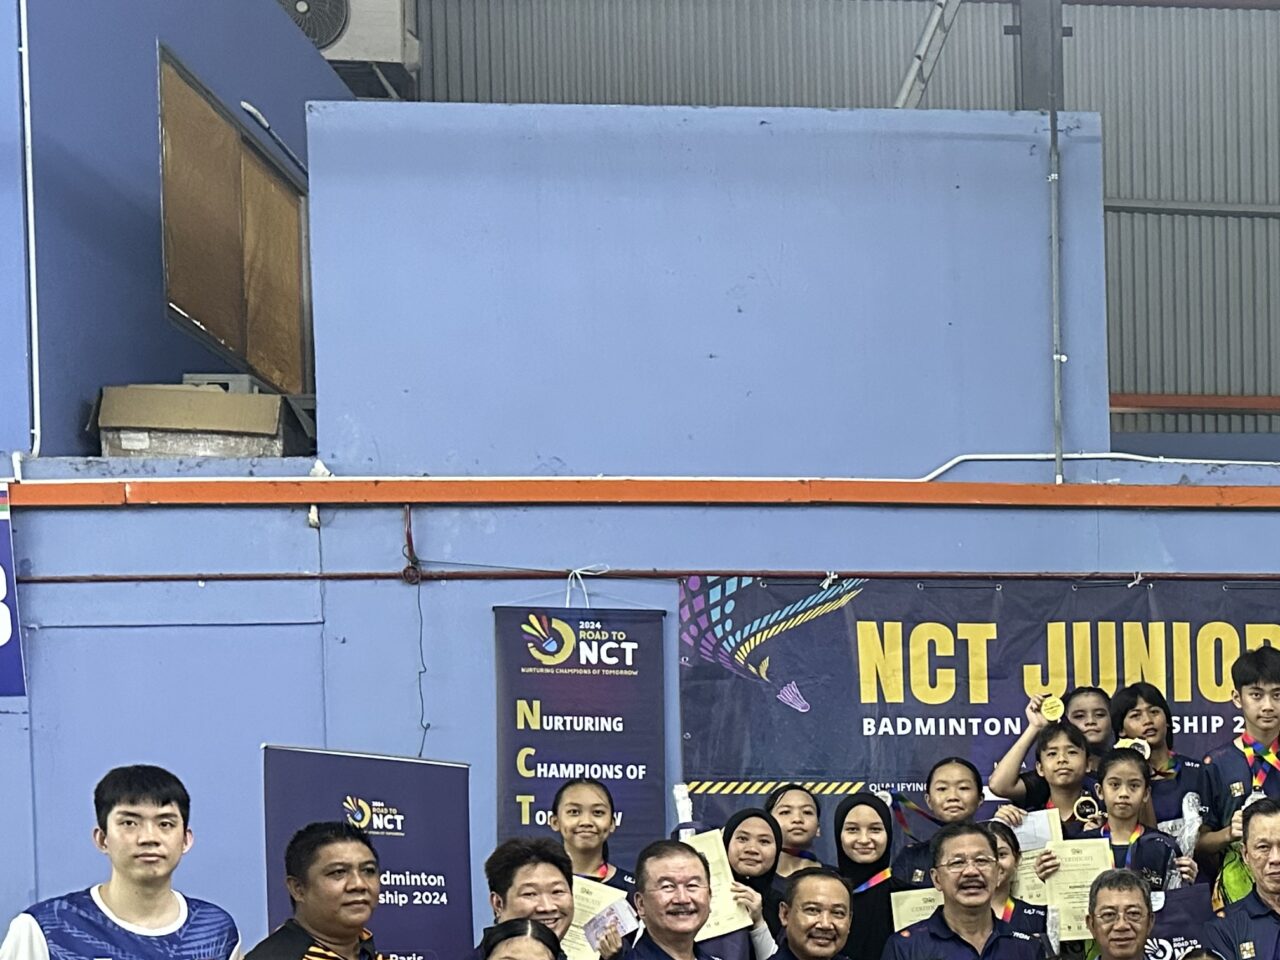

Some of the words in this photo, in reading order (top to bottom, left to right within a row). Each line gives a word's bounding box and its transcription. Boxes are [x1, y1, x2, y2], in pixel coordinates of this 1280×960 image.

[580, 621, 601, 629] 2024
[580, 632, 609, 640] ROAD
[612, 632, 626, 640] TO
[580, 642, 638, 665] NCT
[857, 621, 997, 704] NCT
[516, 700, 623, 731] NURTURING
[863, 718, 1021, 736] BADMINTON
[516, 748, 622, 779] CHAMPIONS
[627, 765, 646, 779] OF
[373, 814, 404, 830] NCT
[380, 871, 445, 887] dminton
[413, 892, 448, 905] 2024
